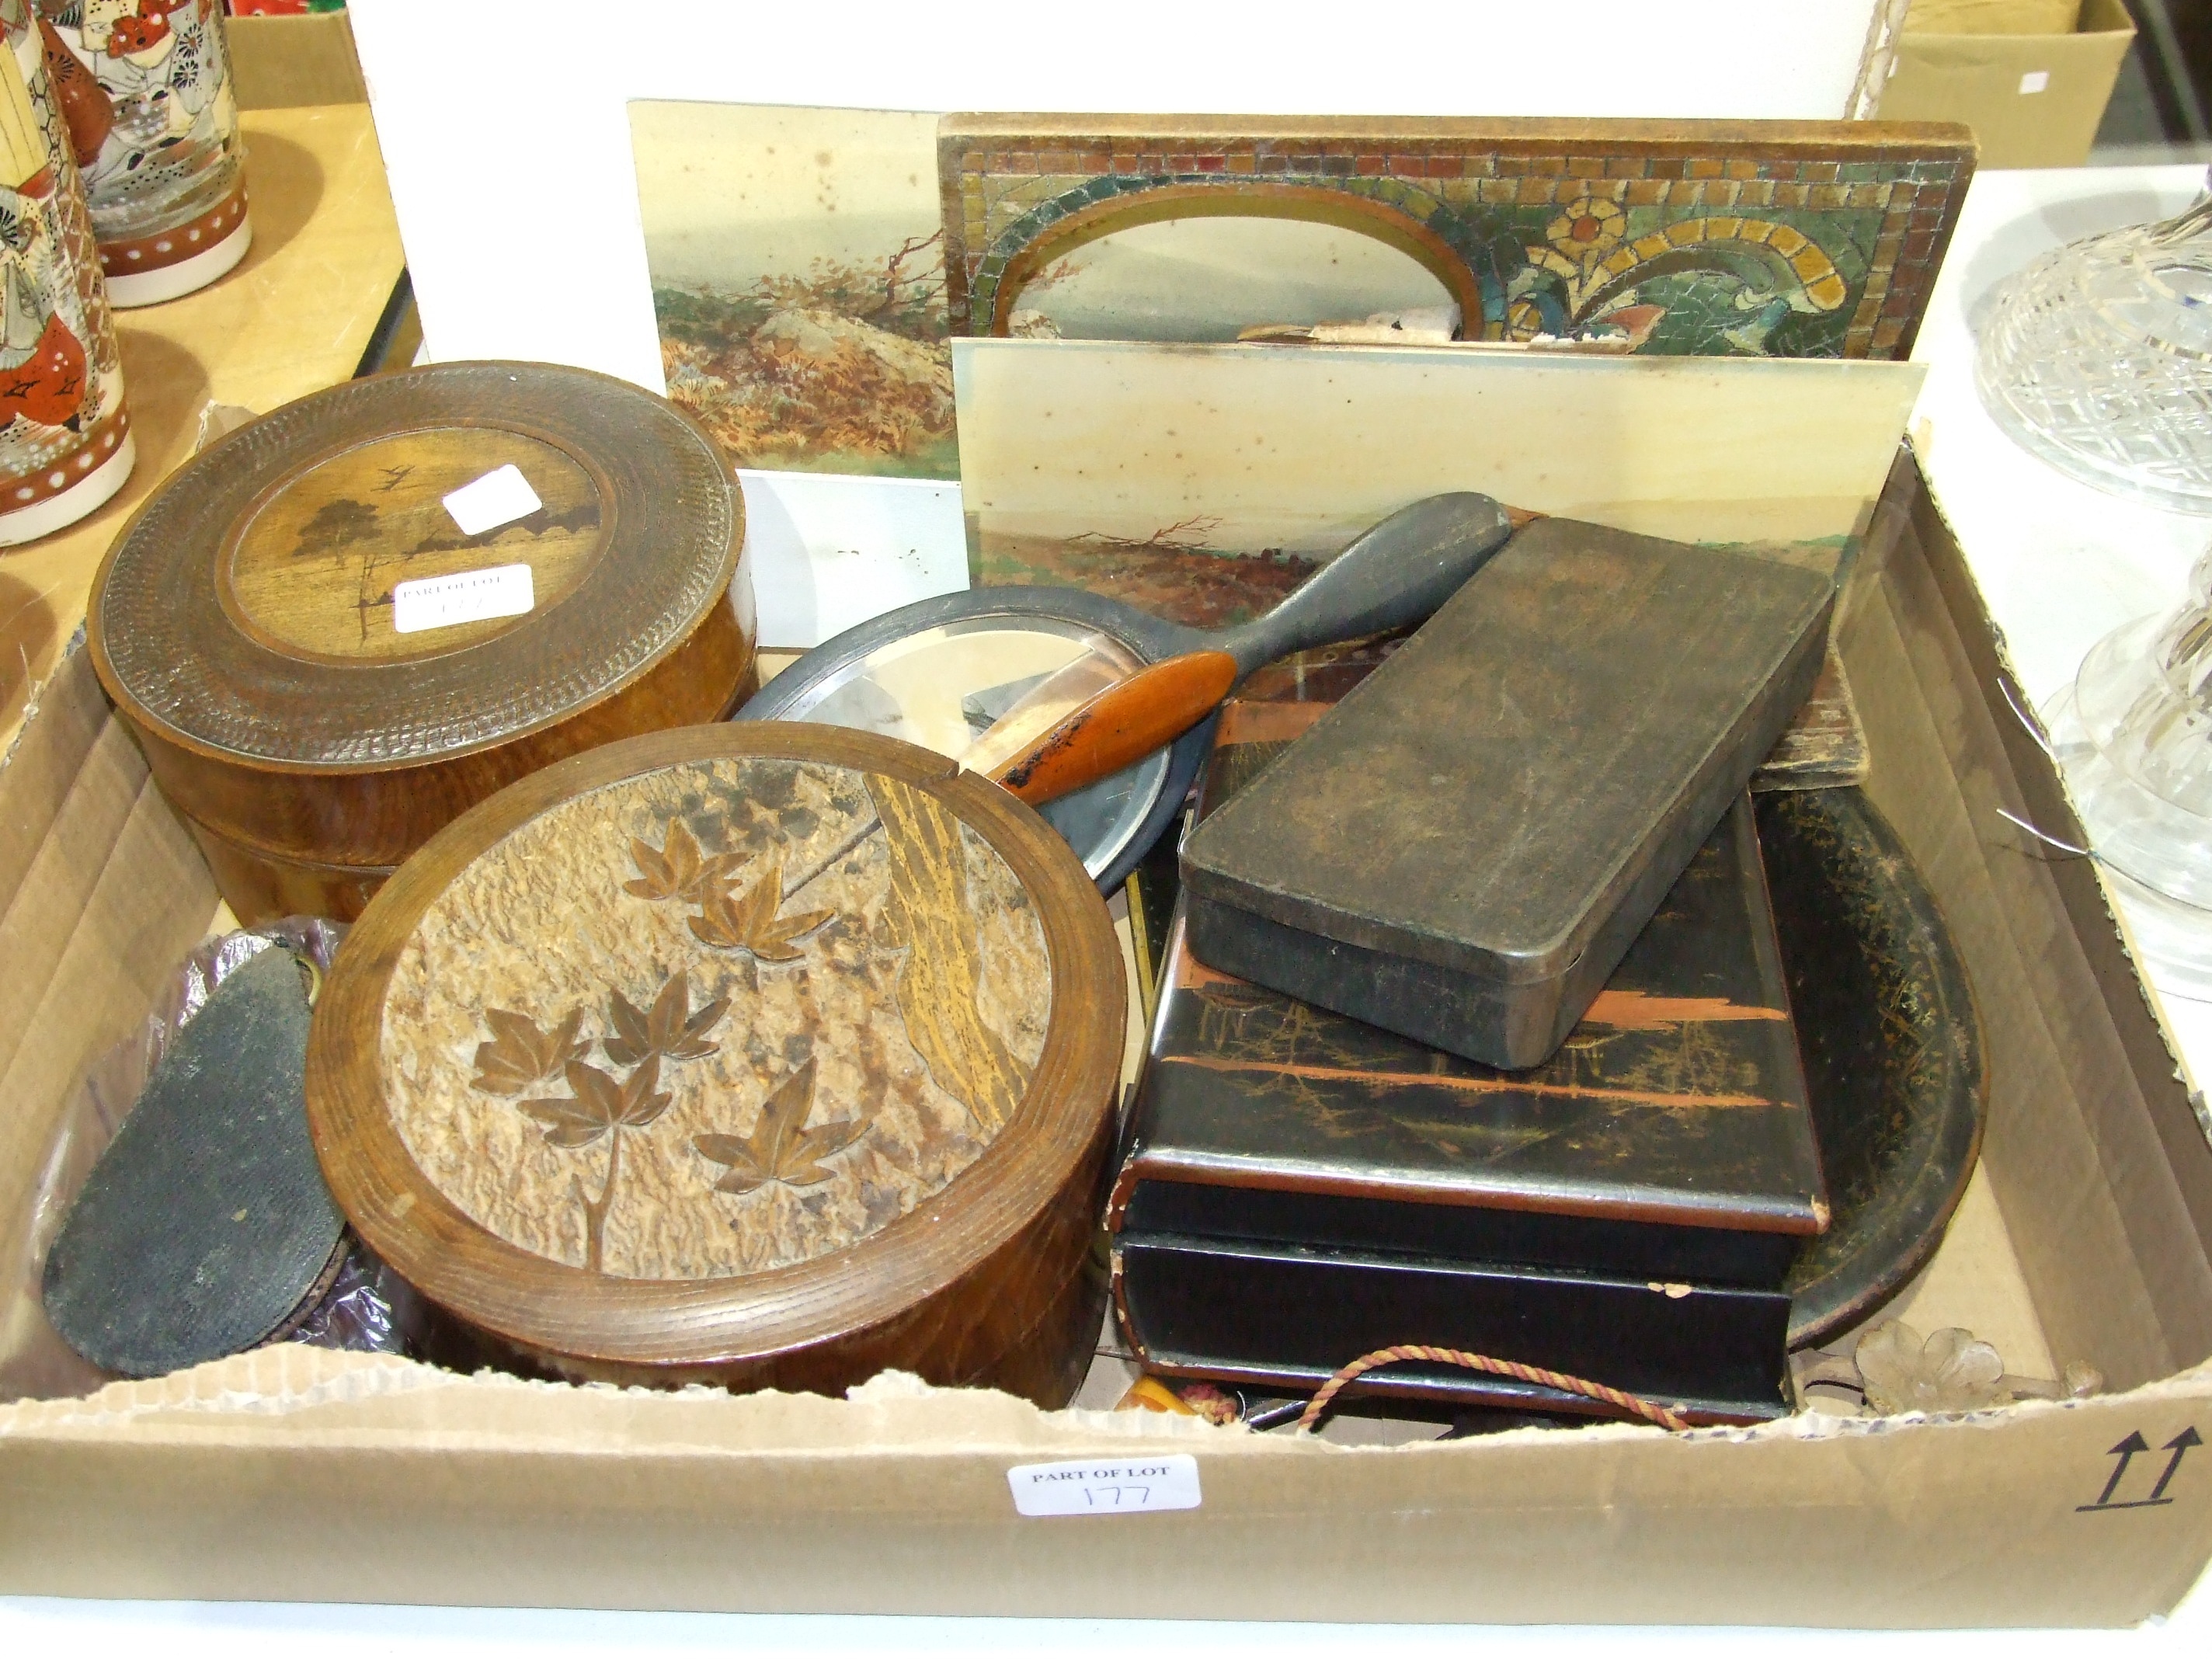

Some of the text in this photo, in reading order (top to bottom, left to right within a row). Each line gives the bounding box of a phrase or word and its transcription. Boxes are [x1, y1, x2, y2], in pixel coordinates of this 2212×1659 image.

[1032, 1466, 1170, 1483] PART OF LOT
[1084, 1487, 1149, 1505] 177
